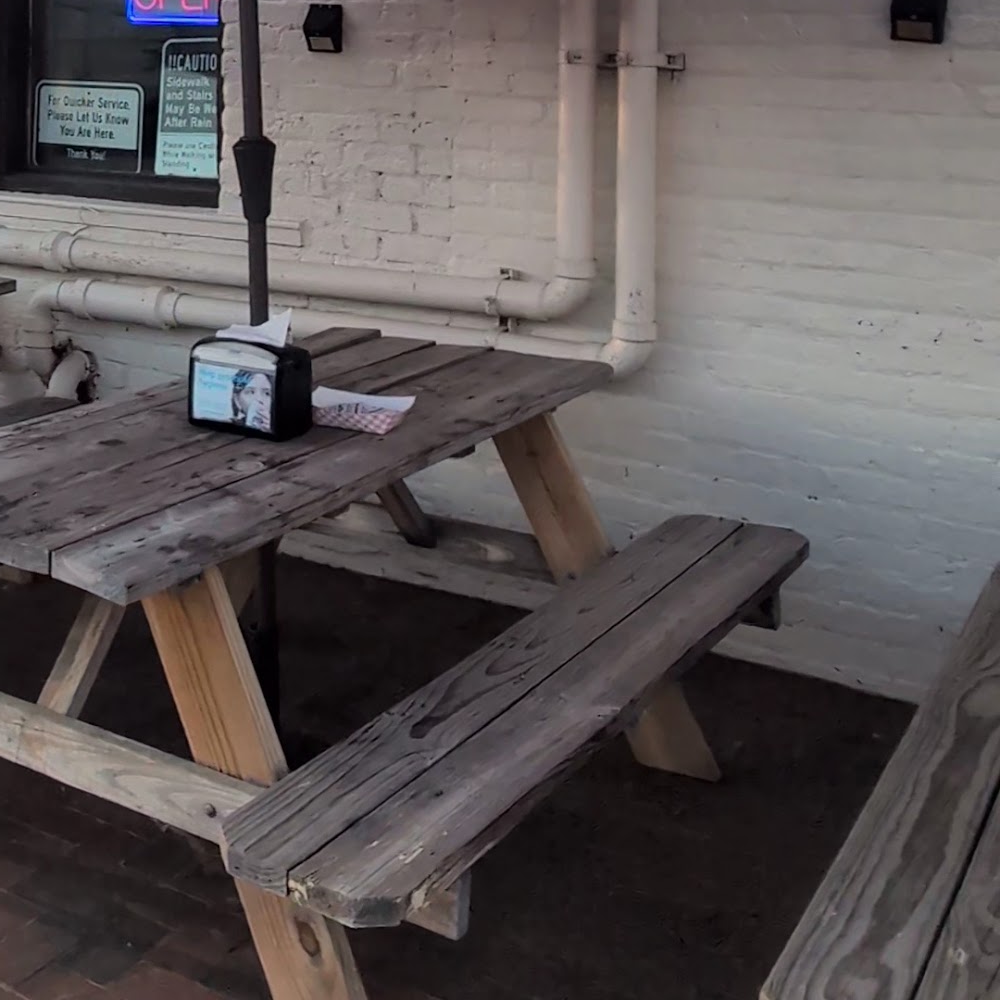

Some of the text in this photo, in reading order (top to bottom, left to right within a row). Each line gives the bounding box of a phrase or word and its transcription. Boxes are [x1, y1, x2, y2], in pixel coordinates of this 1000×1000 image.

[168, 54, 218, 71] !!CAUTIO
[166, 76, 210, 88] Sidewalk
[48, 94, 60, 106] For
[63, 95, 95, 107] Quicker
[166, 89, 213, 101] and Stairs
[165, 103, 217, 116] May Be We
[47, 109, 129, 125] Please Let Us Know
[164, 117, 212, 128] After Rain
[60, 124, 75, 137] You
[77, 126, 91, 138] Are
